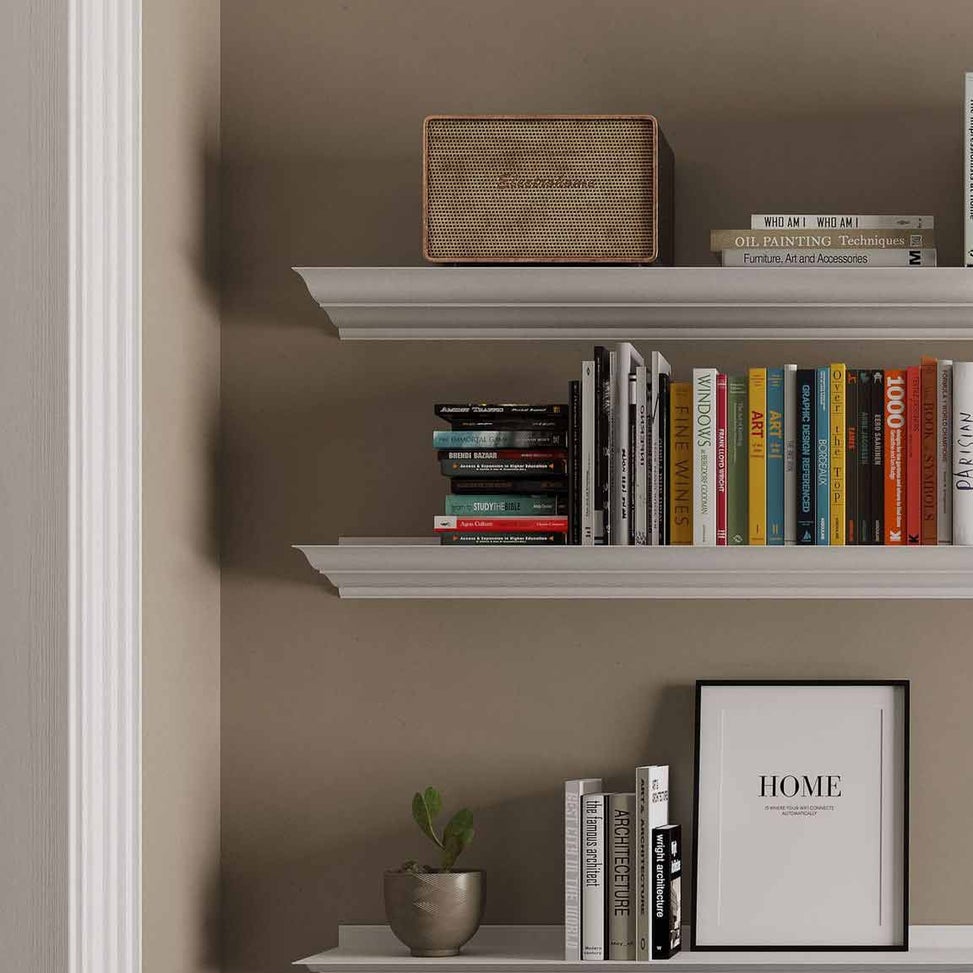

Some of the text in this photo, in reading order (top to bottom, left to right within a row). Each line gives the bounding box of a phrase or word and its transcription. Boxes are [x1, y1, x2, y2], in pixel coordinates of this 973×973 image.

[735, 235, 905, 248] OIL PAINTING Techniques
[764, 217, 785, 228] WHO
[787, 217, 800, 228] AM
[817, 217, 837, 228] WHO
[840, 217, 853, 228] AM
[785, 254, 798, 264] Art
[799, 254, 815, 264] and
[817, 254, 868, 264] Accessories
[697, 374, 711, 447] WINDOWS
[751, 410, 763, 438] ART
[770, 410, 782, 438] ART
[887, 376, 905, 428] 1000
[675, 406, 690, 527] FINE WINES
[802, 384, 810, 513] GRAPHIC DESIGN REFERENCED
[818, 439, 827, 486] BORDEAUX
[924, 402, 934, 521] BOOK SYMBOLS
[758, 775, 842, 798] HOME
[586, 800, 603, 887] the famous architect
[614, 809, 631, 917] ARCHITECETURE
[655, 834, 665, 918] wright architecture
